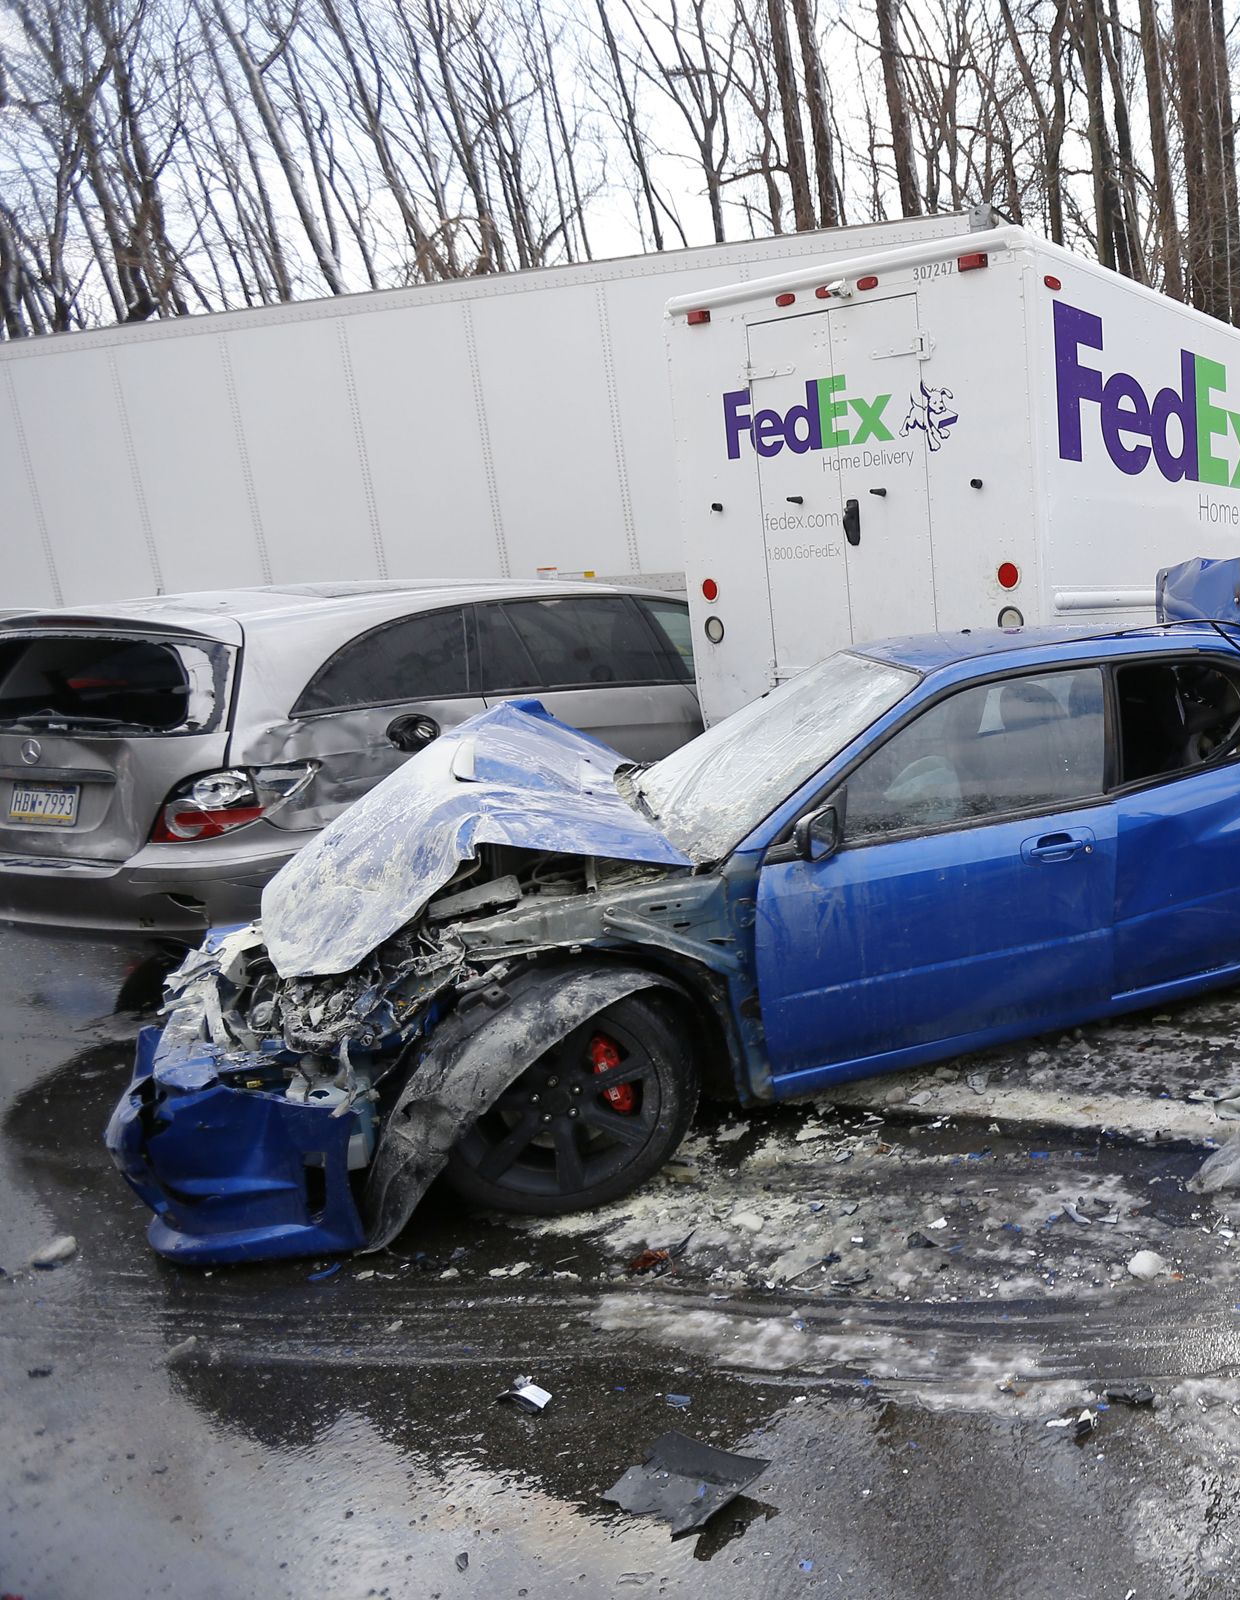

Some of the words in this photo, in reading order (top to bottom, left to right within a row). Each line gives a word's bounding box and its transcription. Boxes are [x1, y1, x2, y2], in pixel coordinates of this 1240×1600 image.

[913, 261, 953, 281] 307247
[723, 374, 896, 460] FedEx
[822, 456, 861, 472] Home
[863, 449, 914, 466] Delivery
[1198, 493, 1239, 525] Home
[765, 512, 839, 531] fedex.com
